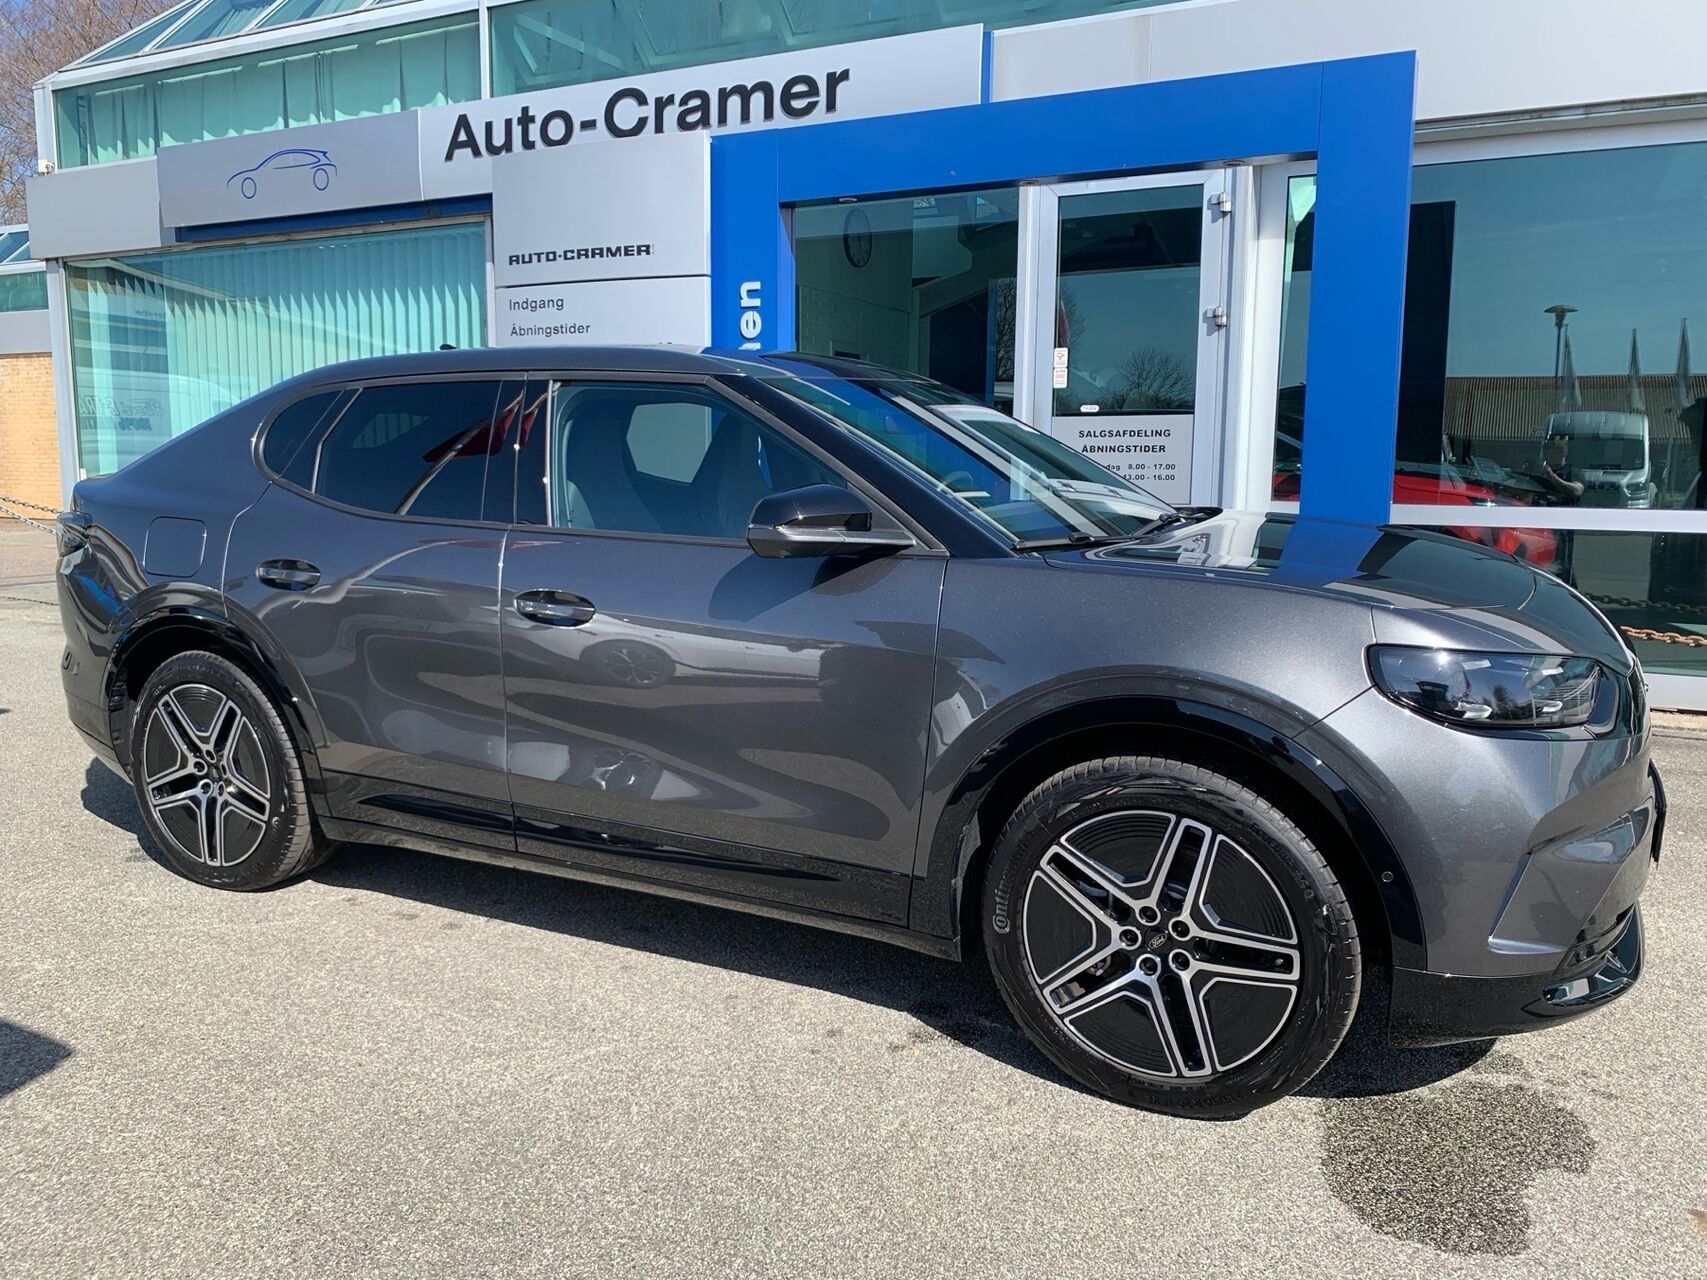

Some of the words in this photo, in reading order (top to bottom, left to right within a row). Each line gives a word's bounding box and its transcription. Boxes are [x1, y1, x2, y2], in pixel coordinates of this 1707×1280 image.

[444, 67, 850, 163] Auto-Cramer
[508, 298, 565, 313] Indgang
[509, 323, 591, 338] Åbningstider
[1078, 429, 1171, 438] SALGSAFDELING
[1081, 444, 1166, 453] ÅBNINGSTIDER
[1104, 463, 1121, 472] dag
